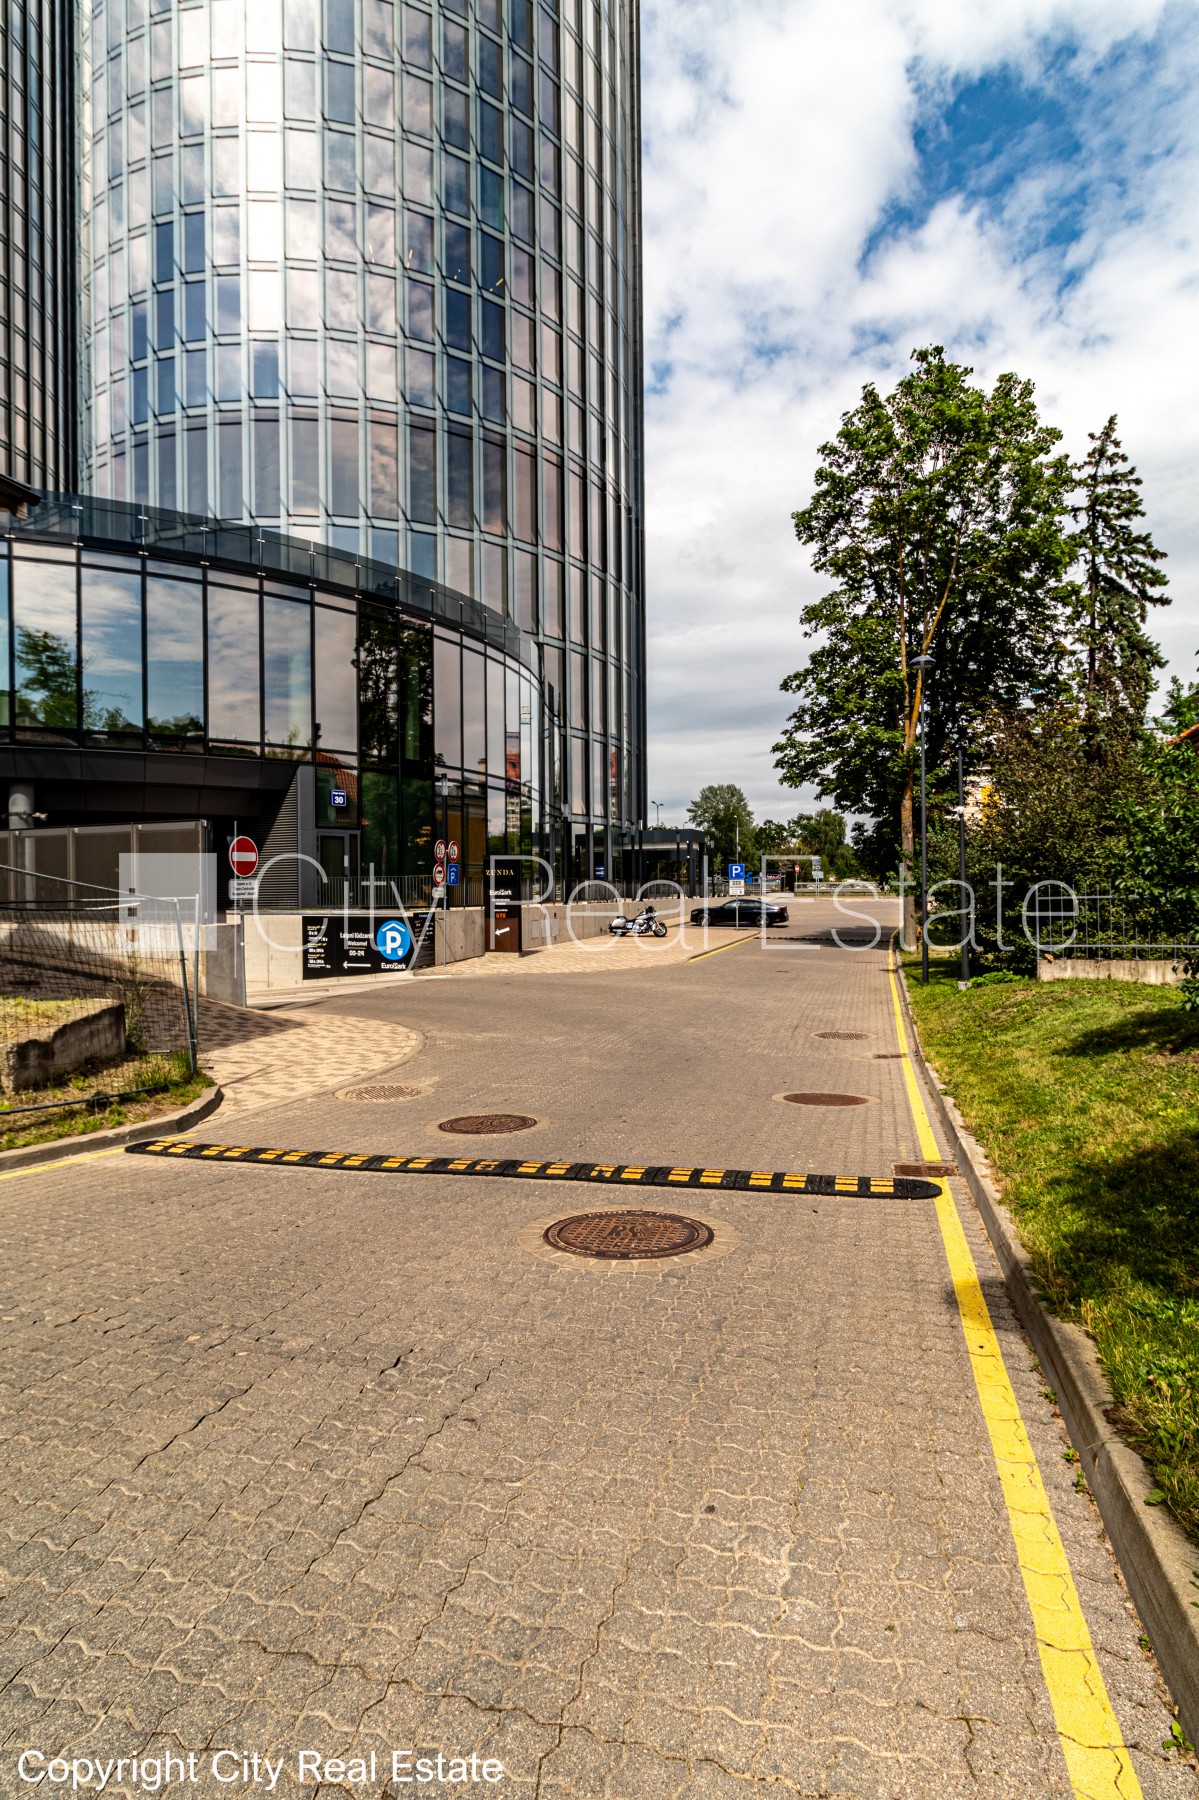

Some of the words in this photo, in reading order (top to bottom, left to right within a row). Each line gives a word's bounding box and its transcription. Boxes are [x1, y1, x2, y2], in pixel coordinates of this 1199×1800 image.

[335, 796, 344, 804] 30
[732, 865, 741, 878] P
[386, 930, 402, 955] P
